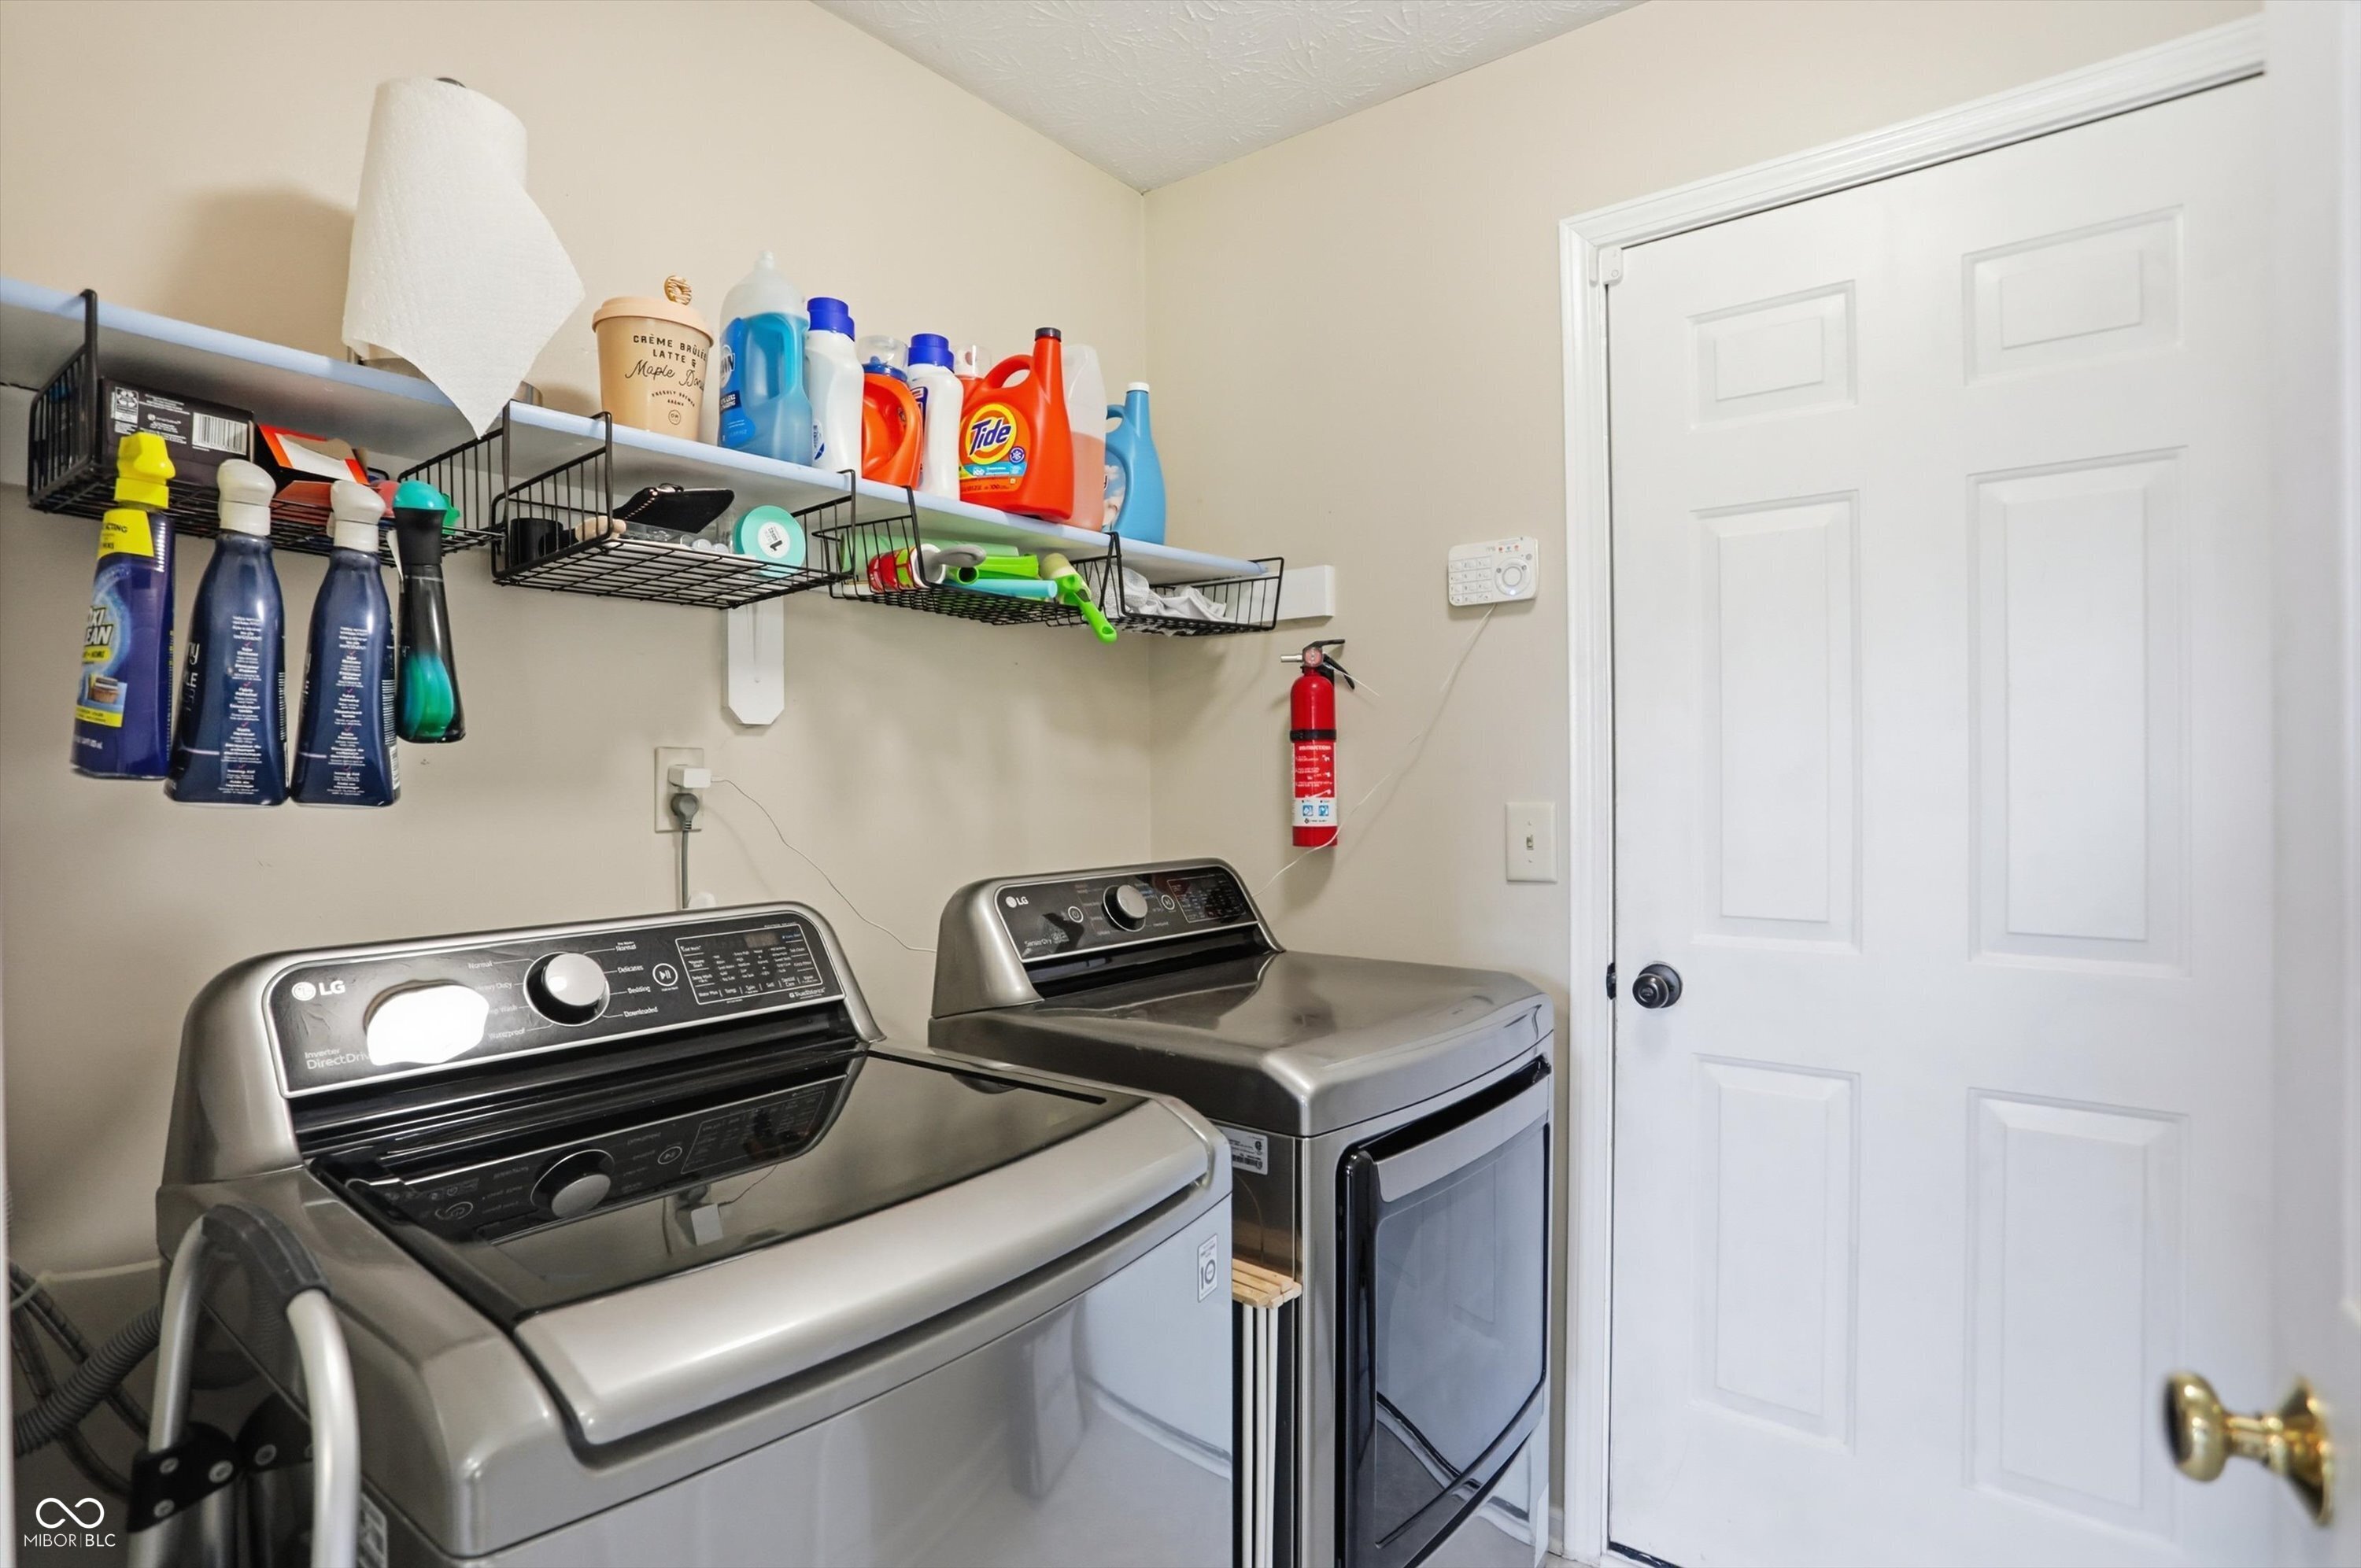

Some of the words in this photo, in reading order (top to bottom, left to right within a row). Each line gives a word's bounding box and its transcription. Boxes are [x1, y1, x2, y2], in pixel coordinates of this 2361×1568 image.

[633, 334, 673, 348] CRÈME
[652, 349, 686, 363] LATTE
[625, 359, 675, 381] Maple
[968, 417, 1012, 456] Tide
[1016, 896, 1029, 906] LG
[319, 980, 345, 996] LG
[623, 1006, 659, 1018] Downloaded
[304, 1048, 341, 1059] Inverter
[306, 1051, 370, 1070] DirectDriv
